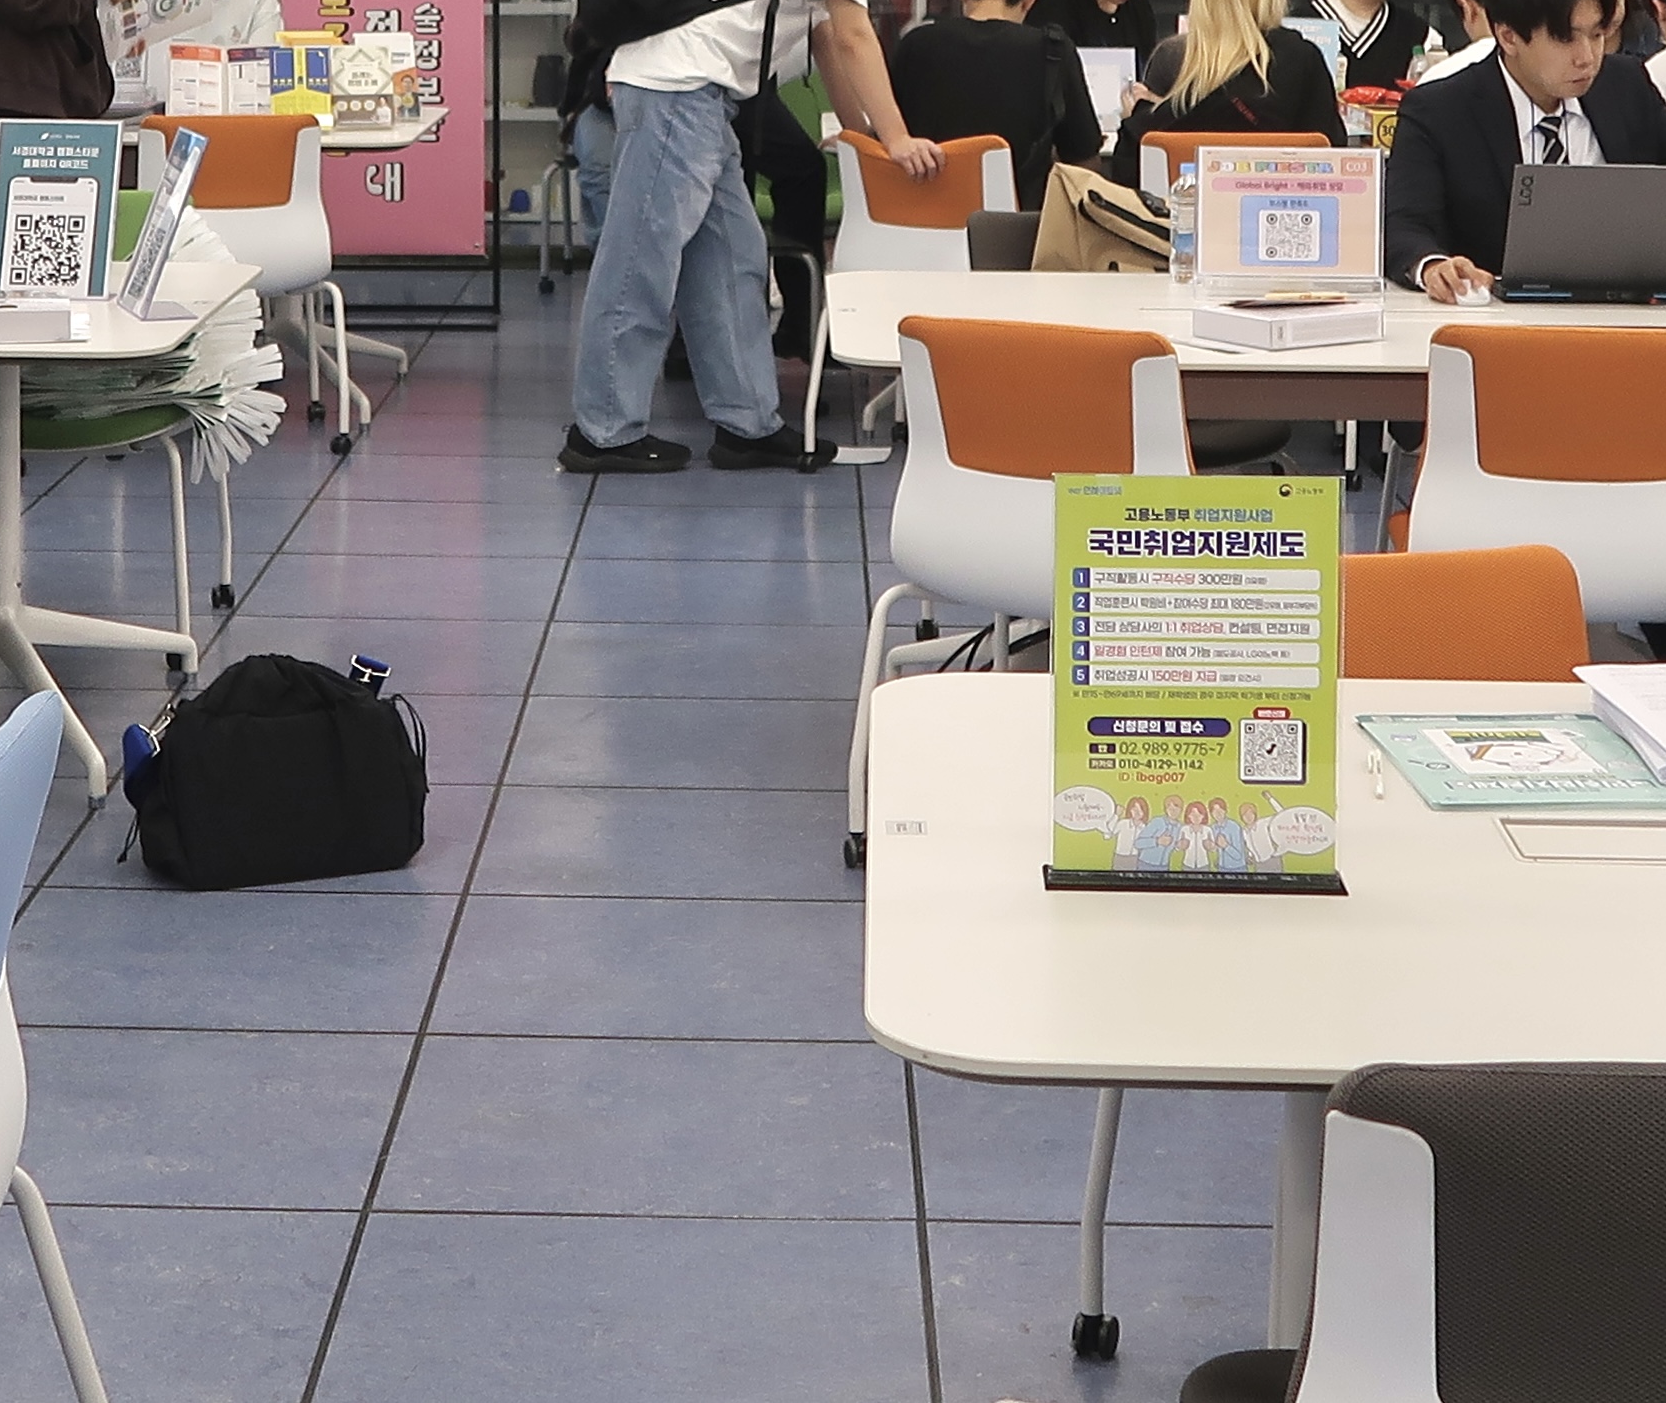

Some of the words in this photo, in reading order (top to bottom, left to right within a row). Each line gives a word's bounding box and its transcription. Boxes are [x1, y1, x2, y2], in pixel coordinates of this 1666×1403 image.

[1124, 507, 1190, 523] 고용노동부
[1194, 508, 1273, 524] 취업지원사업
[1089, 528, 1306, 558] 국민취업지원제도
[1198, 573, 1243, 586] 300만원
[1112, 719, 1161, 733] 신청문의
